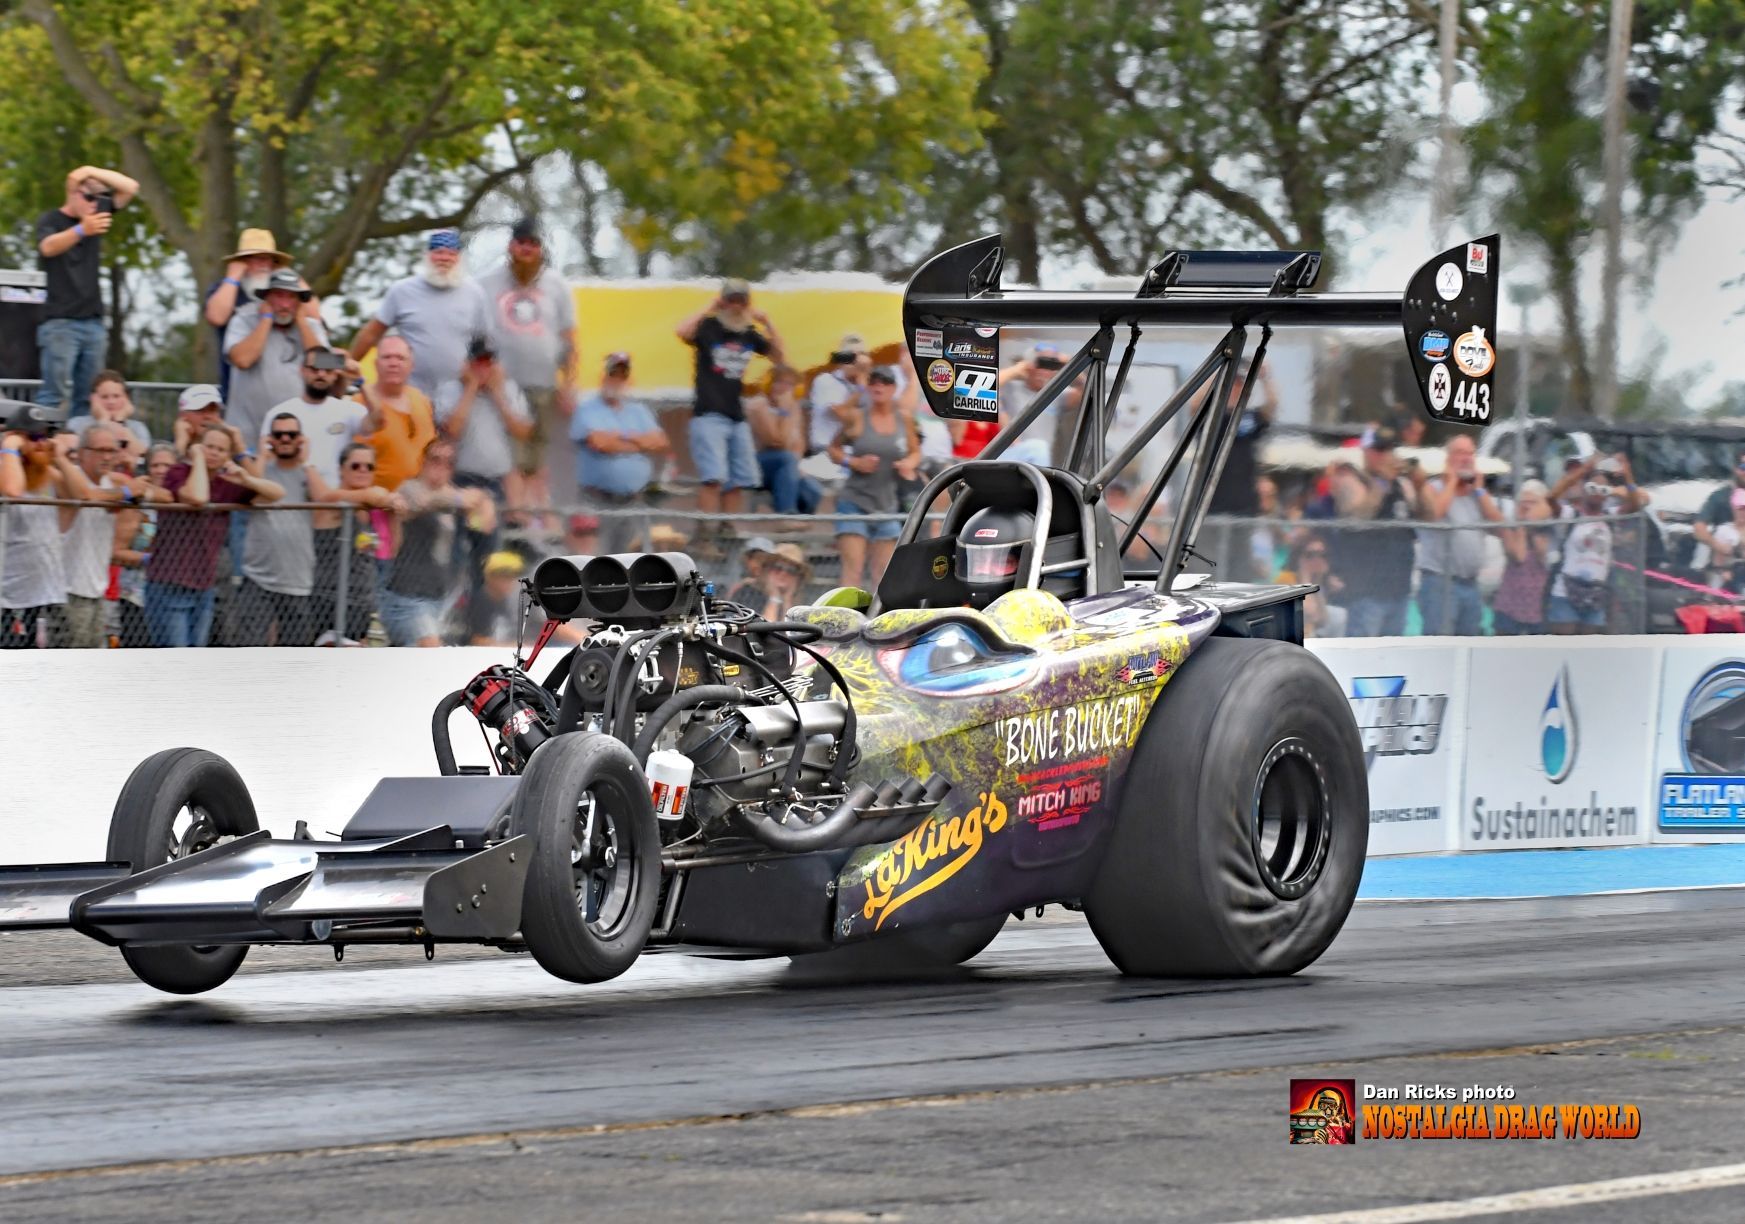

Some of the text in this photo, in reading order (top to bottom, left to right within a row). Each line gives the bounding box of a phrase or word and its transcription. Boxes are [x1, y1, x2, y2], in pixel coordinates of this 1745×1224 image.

[955, 370, 996, 397] CP
[1454, 380, 1490, 420] 443
[954, 396, 997, 411] CARRILLO
[995, 694, 1140, 768] "BONE BUCKET"
[1018, 780, 1102, 816] MITCH KING
[1471, 791, 1637, 840] Sustainachem
[1662, 807, 1732, 819] TRAILER
